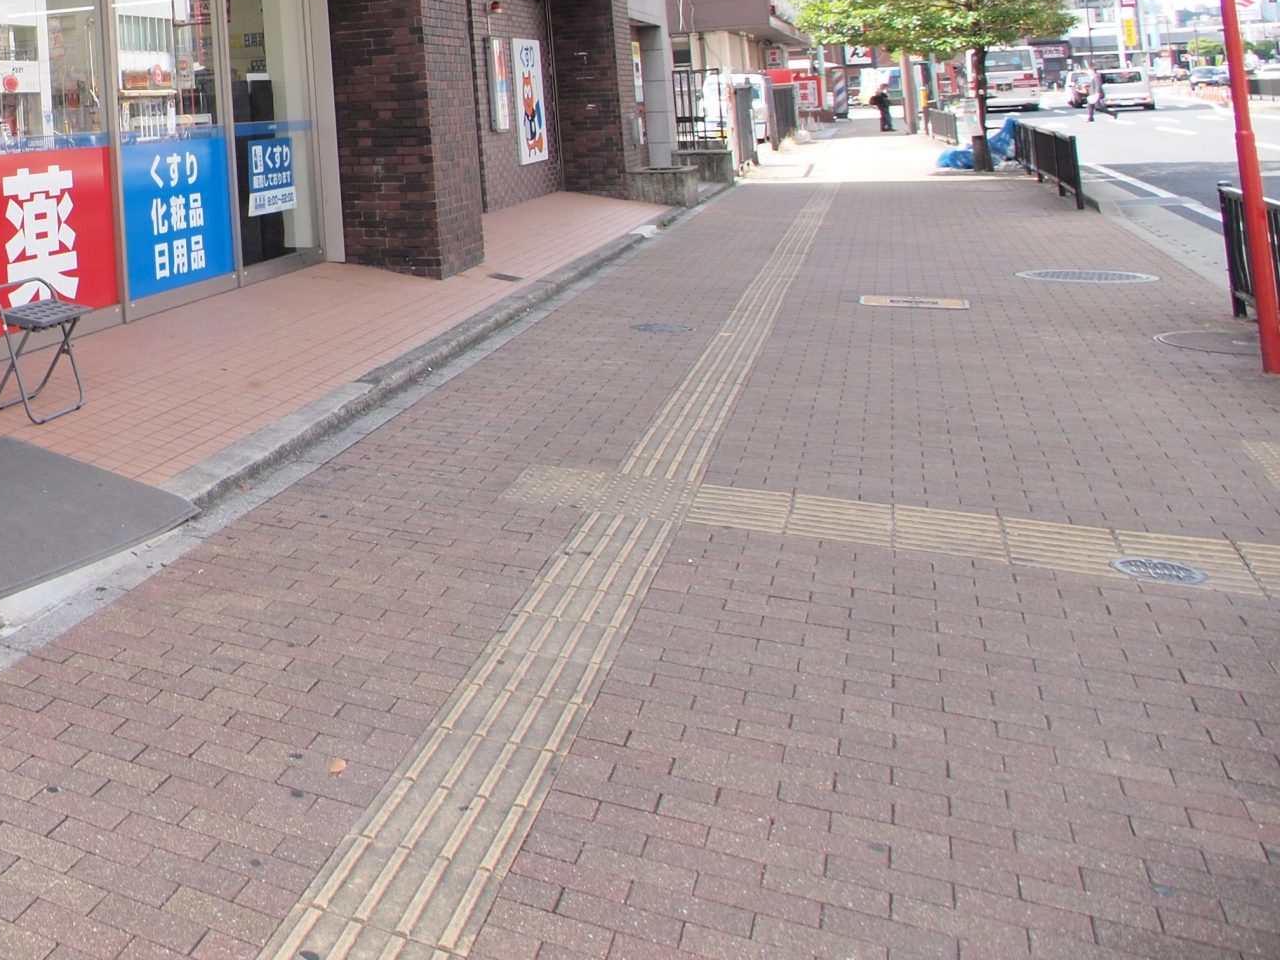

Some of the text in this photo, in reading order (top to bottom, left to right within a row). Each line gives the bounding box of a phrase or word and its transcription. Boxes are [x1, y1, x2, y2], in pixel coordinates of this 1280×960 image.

[519, 45, 535, 69] くすり
[150, 151, 198, 189] くすり
[265, 144, 291, 169] くすり
[151, 192, 204, 236] 化粧品
[2, 164, 80, 308] 薬
[154, 234, 206, 281] 日用品
